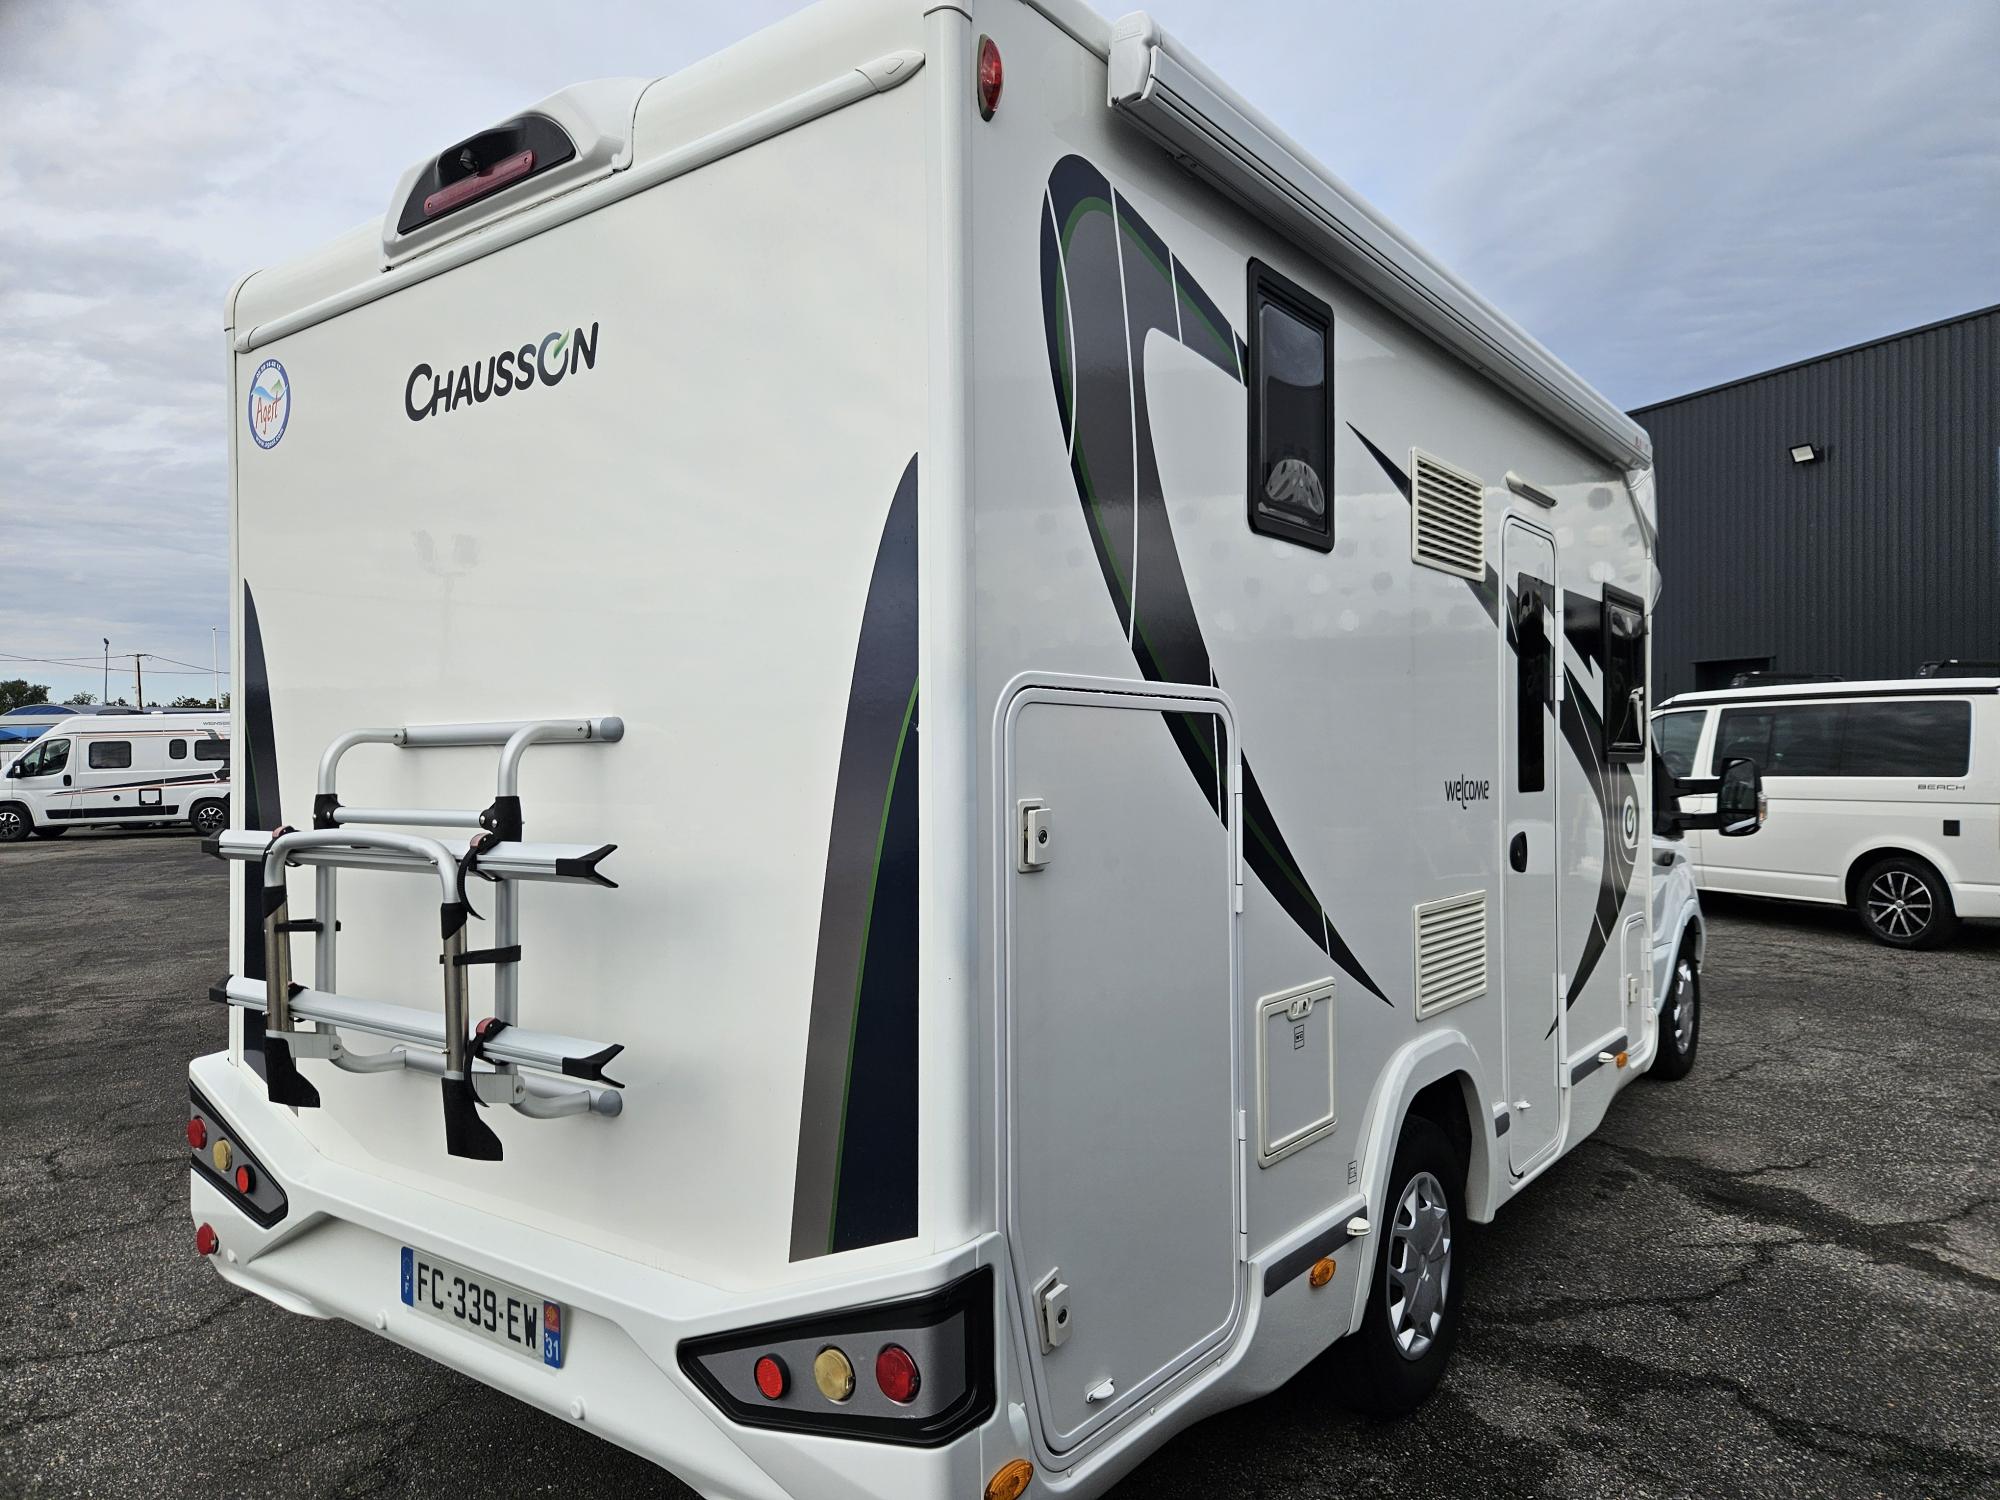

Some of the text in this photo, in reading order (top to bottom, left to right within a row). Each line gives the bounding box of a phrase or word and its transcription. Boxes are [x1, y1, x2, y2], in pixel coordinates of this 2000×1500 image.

[404, 322, 599, 422] CHAUSSON
[1444, 773, 1490, 810] welcome
[417, 1262, 537, 1349] FC-339-EW
[545, 1337, 559, 1361] 31
